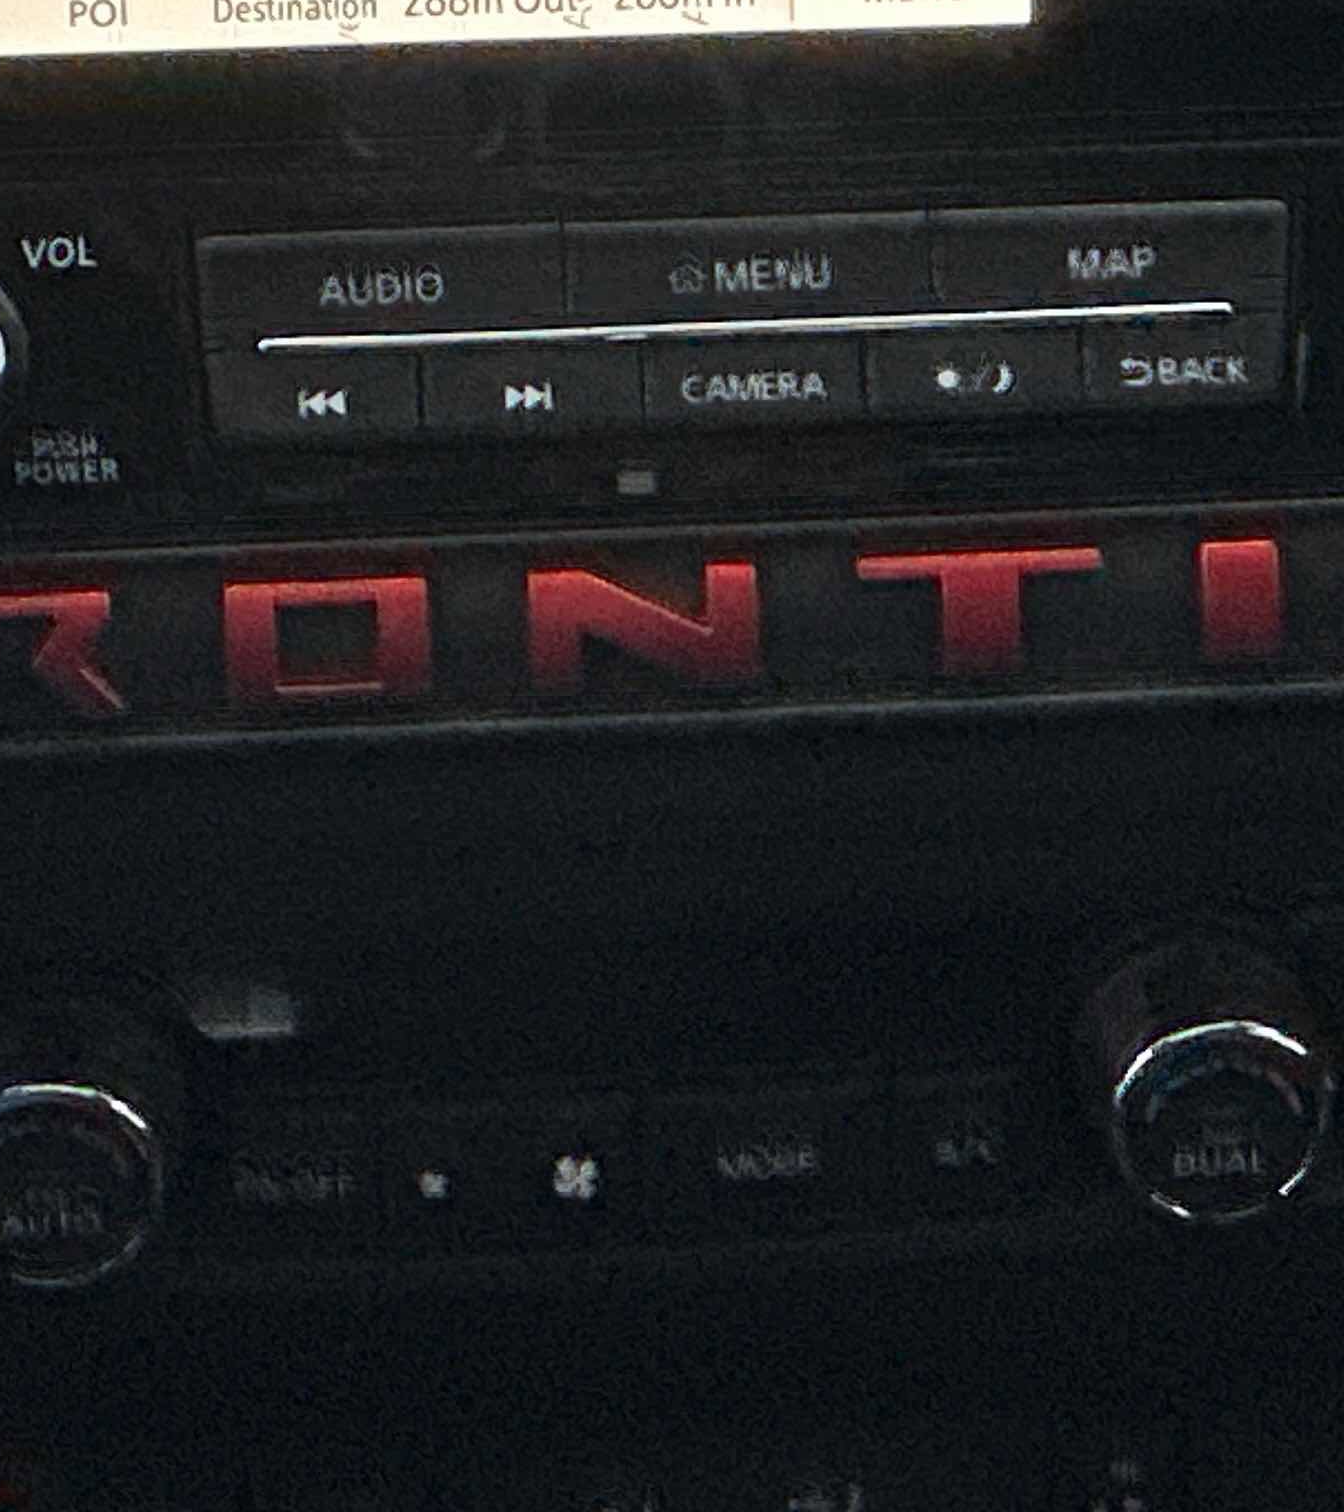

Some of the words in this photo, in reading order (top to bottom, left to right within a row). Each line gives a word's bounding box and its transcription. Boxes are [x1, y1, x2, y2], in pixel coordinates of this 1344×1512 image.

[69, 0, 127, 29] POI
[21, 233, 97, 269] VOL
[1067, 246, 1155, 281] MAP
[320, 266, 444, 307] AUDIO
[713, 252, 834, 292] MENU
[682, 372, 828, 402] CAMERA
[1156, 356, 1249, 386] BACK
[13, 457, 119, 484] POWER
